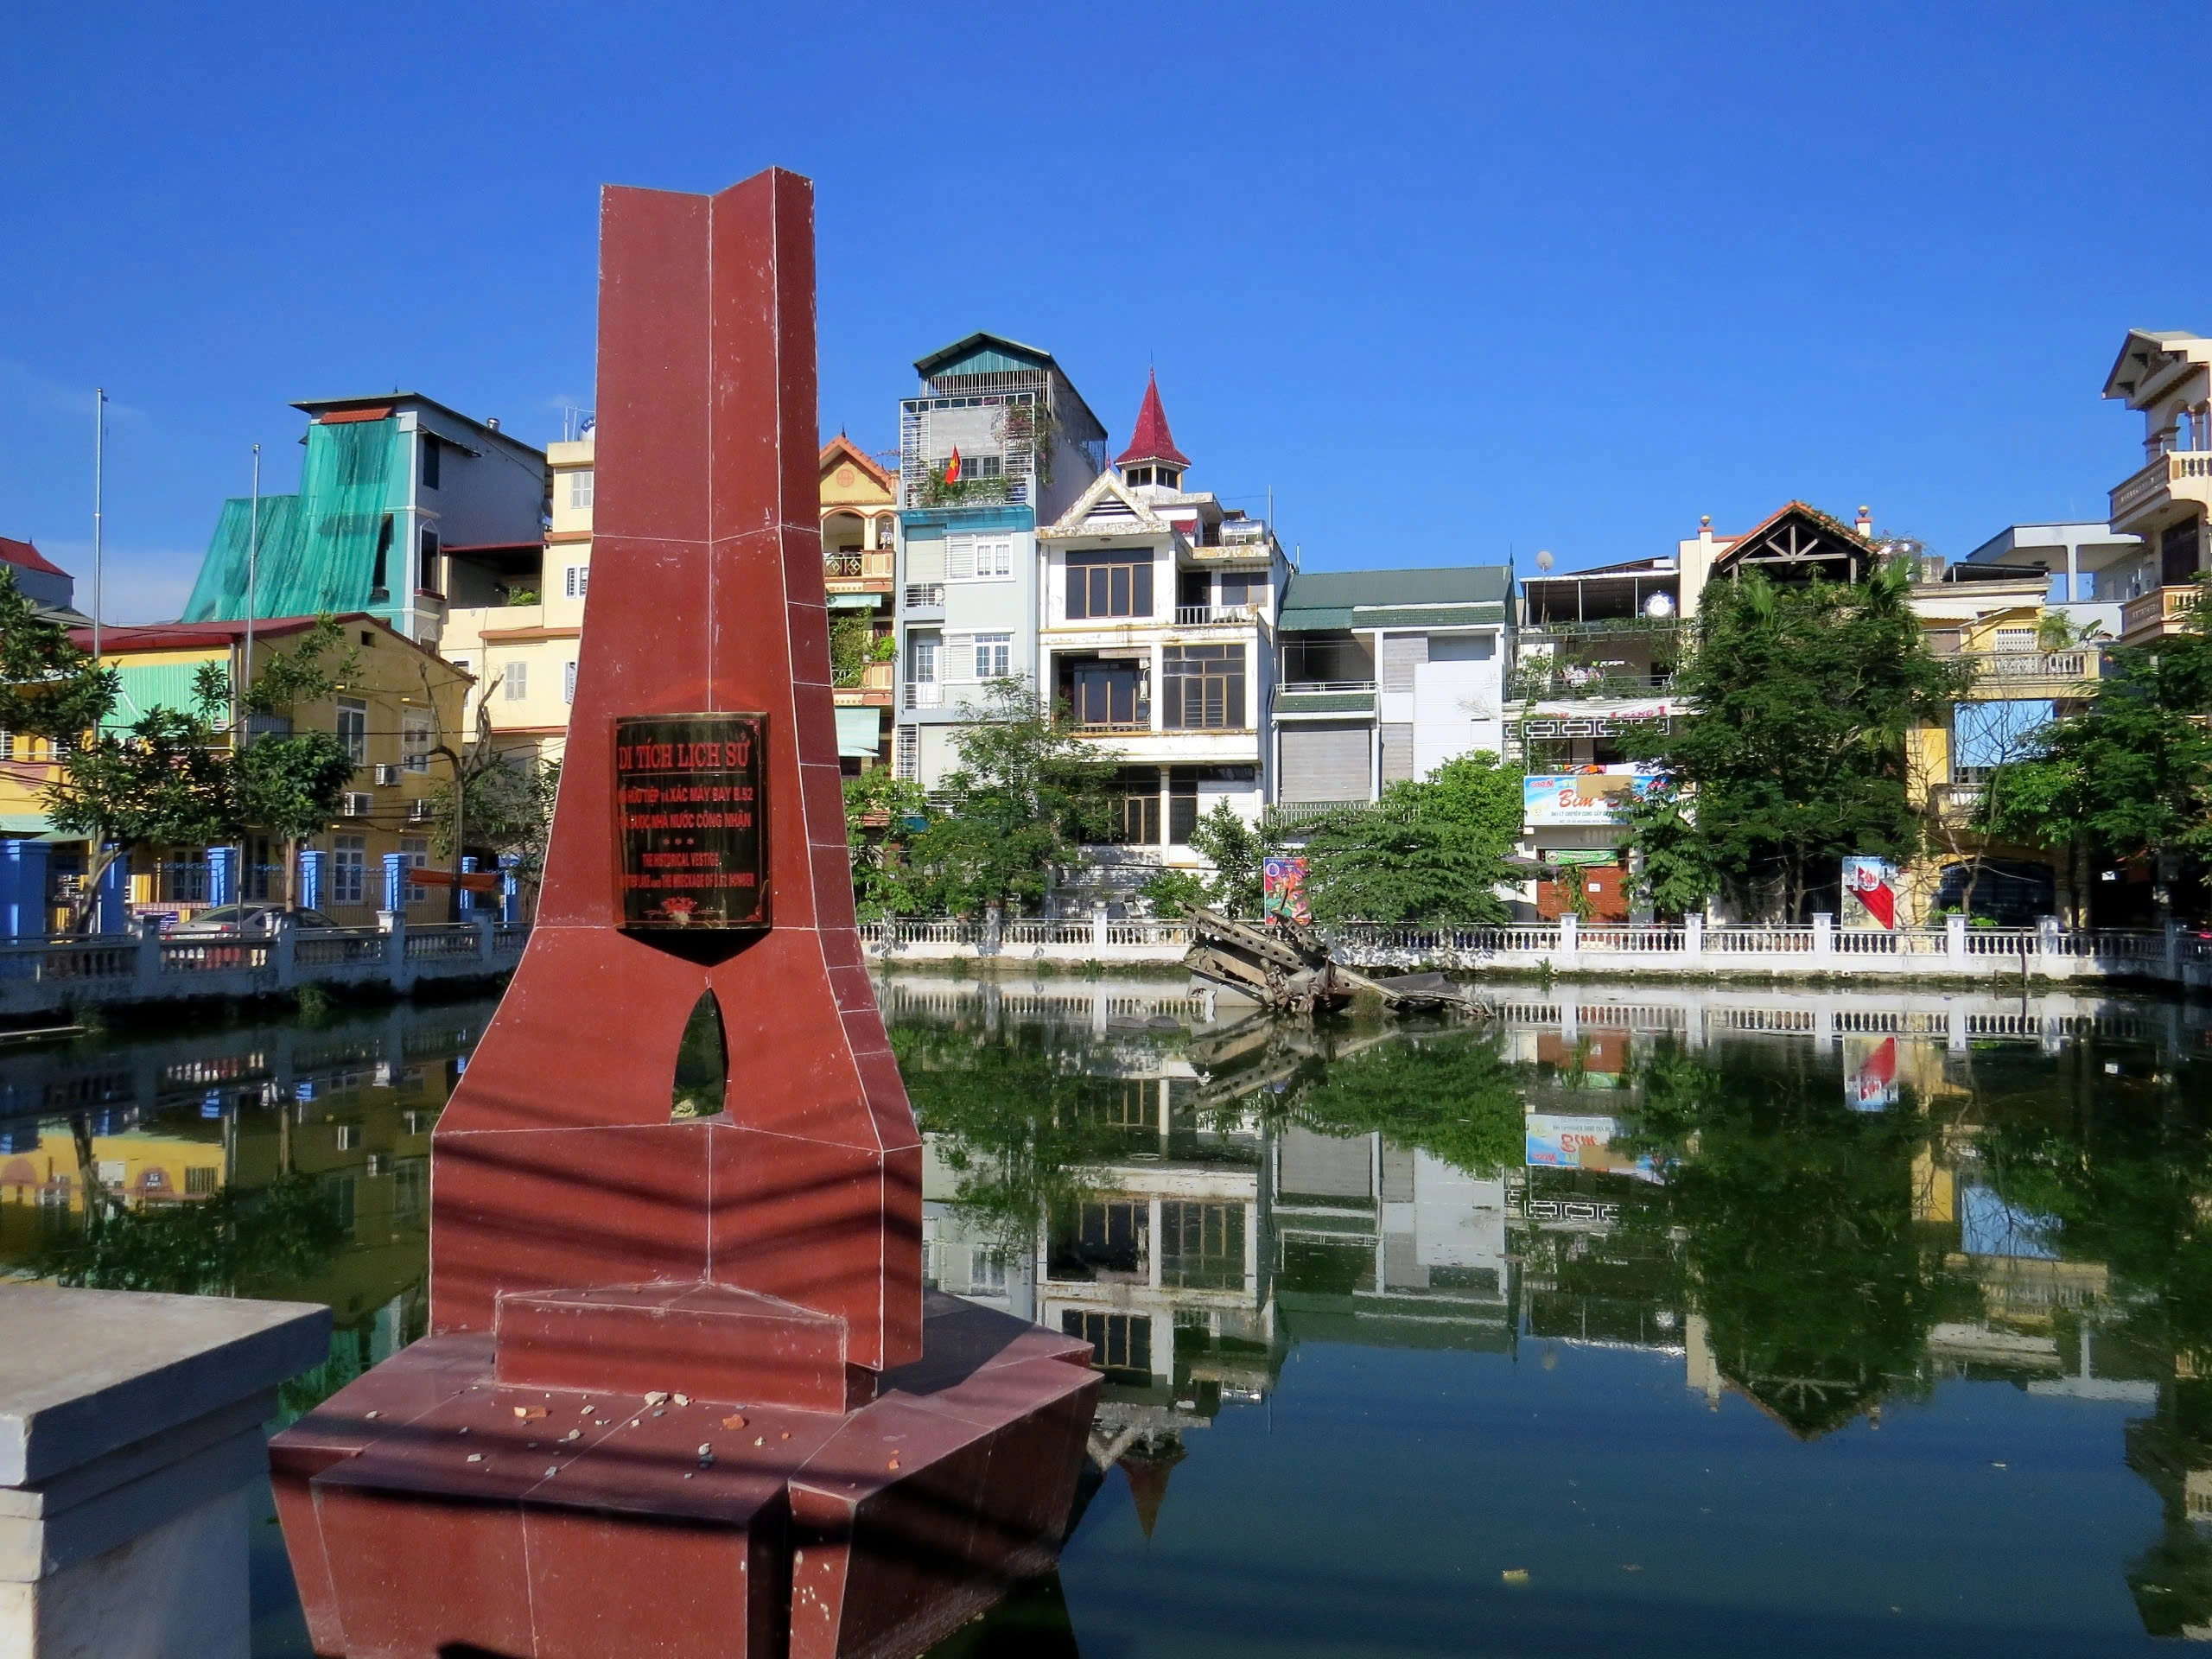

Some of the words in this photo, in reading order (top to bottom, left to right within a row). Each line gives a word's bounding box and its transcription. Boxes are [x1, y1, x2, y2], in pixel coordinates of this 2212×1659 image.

[619, 746, 633, 770] DI
[636, 737, 674, 769] TÍCH
[677, 742, 722, 772] LỊCH
[726, 732, 751, 766] SỬ
[671, 784, 689, 802] XÁC
[690, 784, 711, 802] MÁY
[712, 786, 733, 801] BAY
[696, 809, 723, 827] CÔNG
[724, 809, 752, 831] NHẬN
[690, 852, 719, 867] VESTIGE
